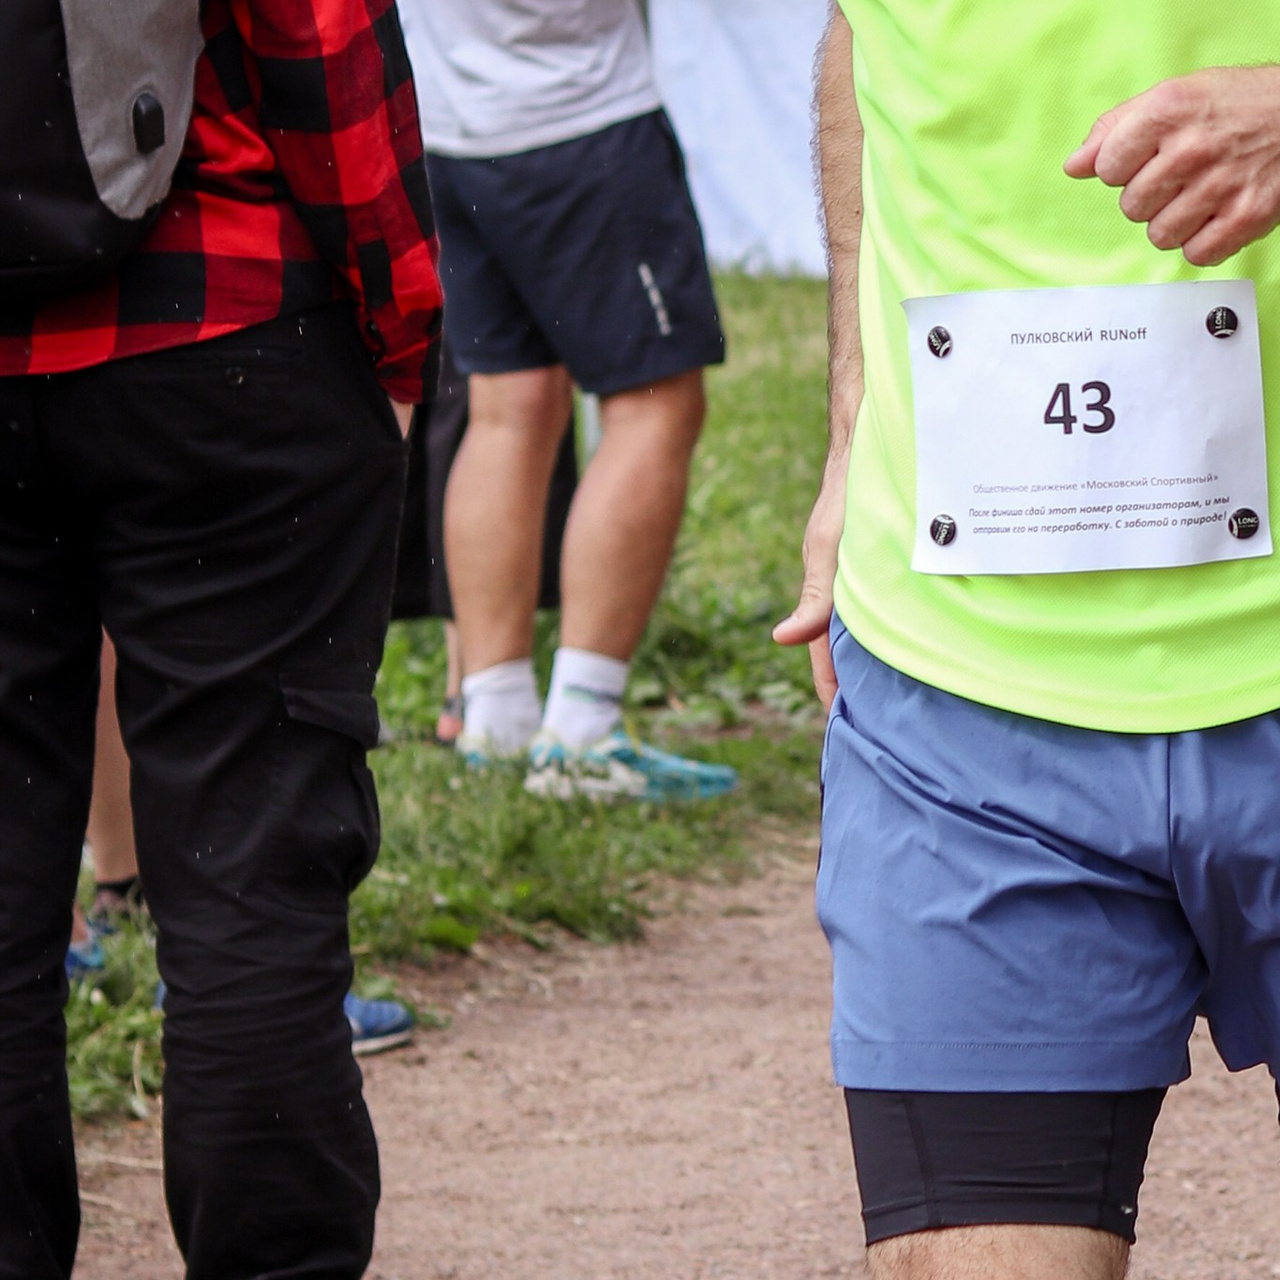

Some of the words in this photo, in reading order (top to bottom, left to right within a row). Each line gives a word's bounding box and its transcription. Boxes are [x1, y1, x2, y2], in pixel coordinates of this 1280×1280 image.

[1011, 328, 1093, 344] ПУЛКОВСКИЙ
[1100, 327, 1147, 341] RUNoff
[1044, 380, 1116, 435] 43
[973, 484, 1028, 494] Общественное
[1030, 482, 1078, 493] движение
[1080, 477, 1148, 490] «Московский
[1150, 473, 1219, 487] Спортивный»
[969, 508, 990, 517] После
[992, 508, 1023, 517] финиша
[1024, 506, 1046, 516] сдай
[1048, 506, 1077, 515] этот
[1079, 504, 1113, 514] номер
[1115, 500, 1202, 513] организаторам,
[1213, 496, 1230, 505] мы
[1012, 525, 1026, 534] его
[1027, 524, 1039, 533] на
[1041, 521, 1112, 534] переработку.
[1115, 519, 1122, 529] С
[1124, 517, 1169, 529] заботой
[1180, 511, 1227, 527] природе!
